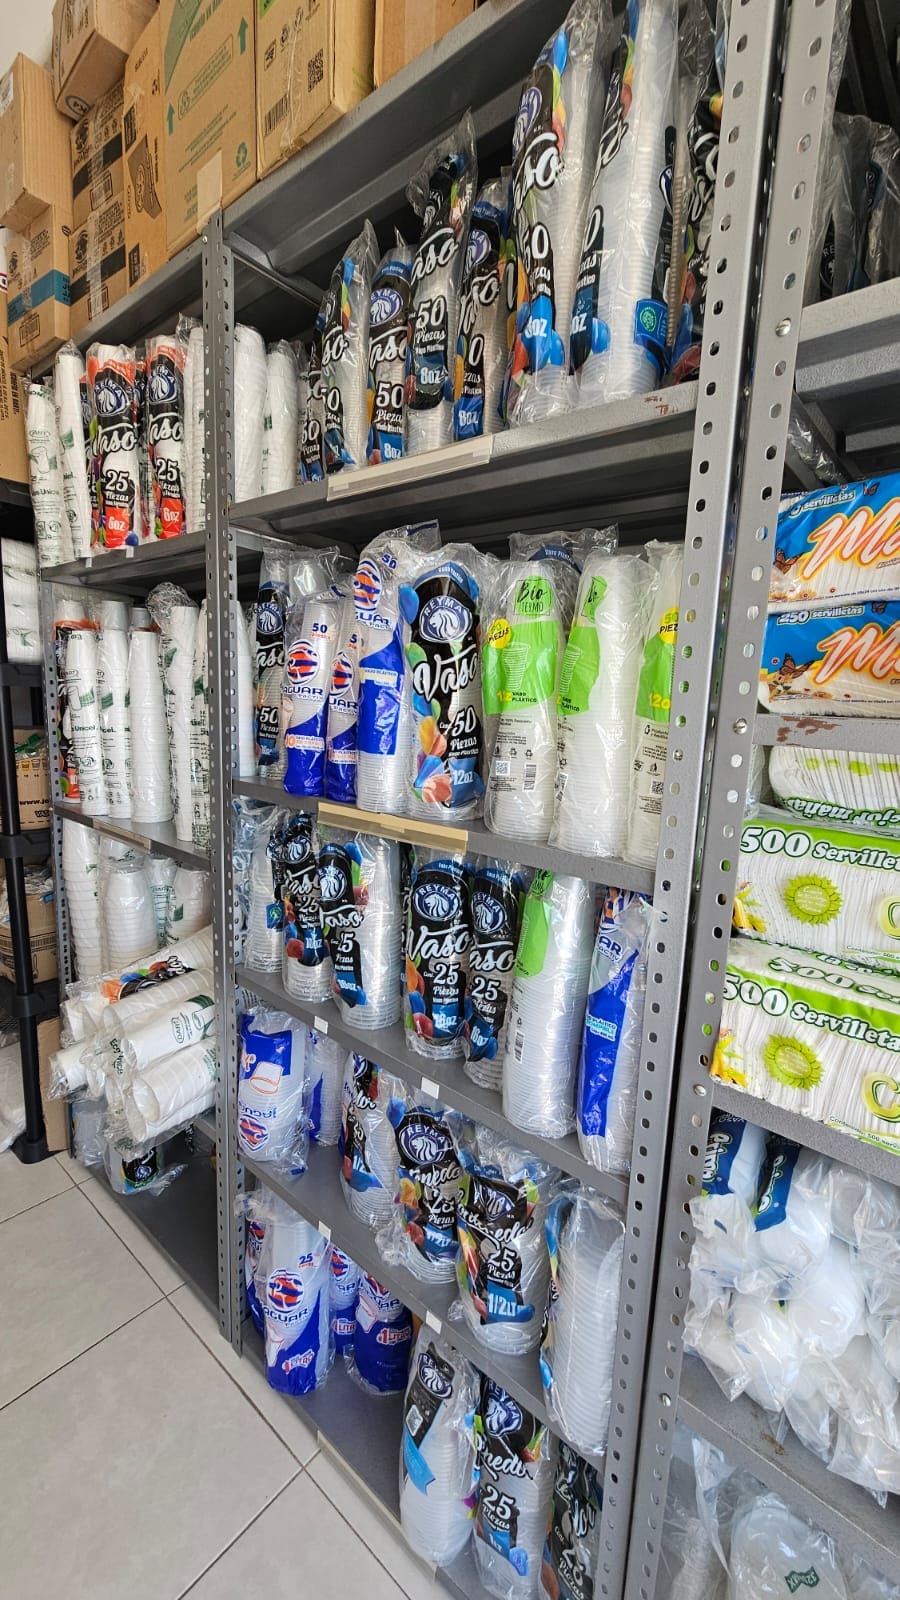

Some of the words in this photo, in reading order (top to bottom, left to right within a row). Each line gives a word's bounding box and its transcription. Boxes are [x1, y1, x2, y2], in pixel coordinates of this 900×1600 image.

[415, 296, 447, 329] 50
[415, 328, 447, 345] Piezas
[419, 367, 442, 386] 8oz
[376, 382, 405, 409] 50
[375, 409, 402, 422] Pieza
[105, 470, 130, 492] 25
[157, 458, 180, 482] 25
[803, 491, 856, 509] servilletas
[108, 518, 126, 531] 6oz
[163, 507, 181, 524] 6oz
[516, 580, 547, 603] Bio
[424, 596, 463, 617] REYMA
[520, 601, 545, 614] TERMO
[777, 609, 811, 625] 250
[811, 606, 864, 618] servilletas
[312, 622, 329, 634] 50
[659, 623, 679, 634] PIEZ
[450, 706, 478, 737] 50
[449, 737, 478, 751] Piezas
[451, 770, 474, 785] 12oz
[740, 827, 812, 858] 500
[419, 884, 456, 900] REYMA
[406, 924, 472, 962] Vaso
[469, 940, 516, 972] aso
[433, 963, 460, 985] 25
[471, 976, 500, 1001] 25
[723, 972, 789, 1017] 500
[406, 1124, 448, 1146] REYMA
[299, 1252, 314, 1265] 25
[487, 1248, 517, 1272] 25
[487, 1263, 516, 1280] Piezas
[488, 1293, 516, 1318] 1/2LT
[339, 1323, 356, 1334] LITR
[488, 1379, 521, 1421] REYMA
[483, 1485, 515, 1519] 25
[482, 1503, 511, 1531] Piezas
